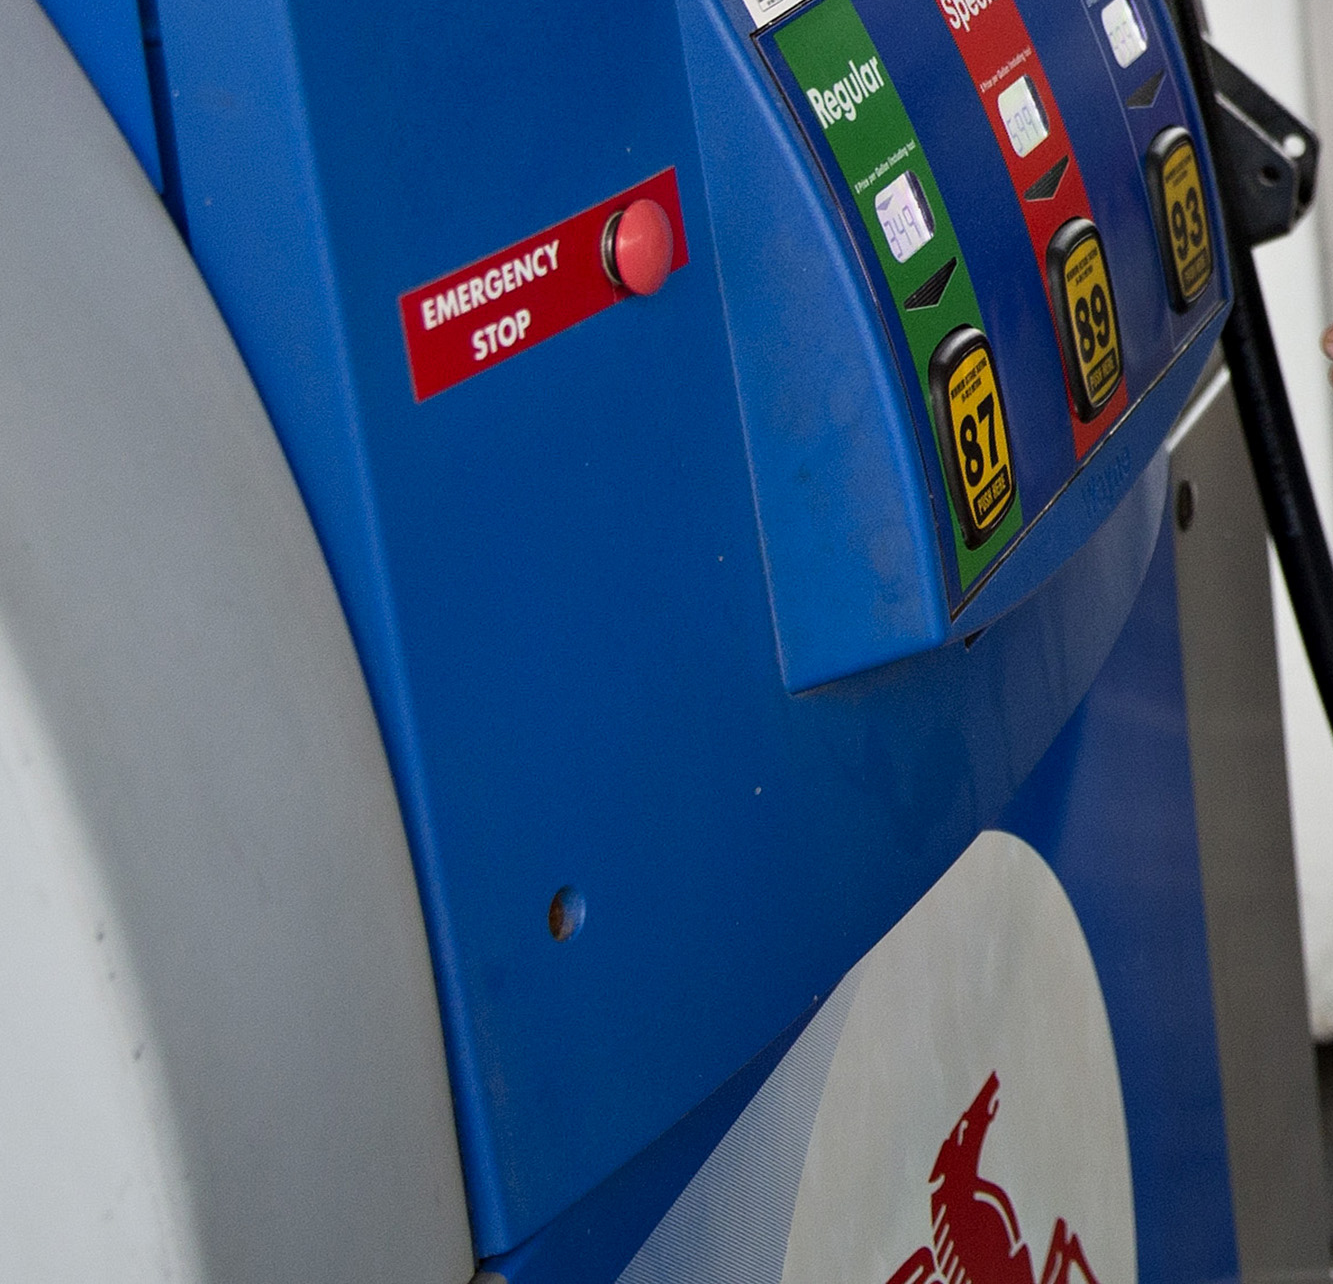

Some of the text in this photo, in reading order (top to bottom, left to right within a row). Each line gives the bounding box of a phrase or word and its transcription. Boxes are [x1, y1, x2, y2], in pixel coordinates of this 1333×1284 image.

[806, 56, 885, 130] Regular
[1171, 186, 1203, 262] 93
[420, 239, 560, 331] EMERGENCY
[471, 308, 532, 362] STOP
[1075, 282, 1111, 365] 89
[960, 392, 1000, 488] 87
[976, 472, 1007, 517] PUSH HERE
